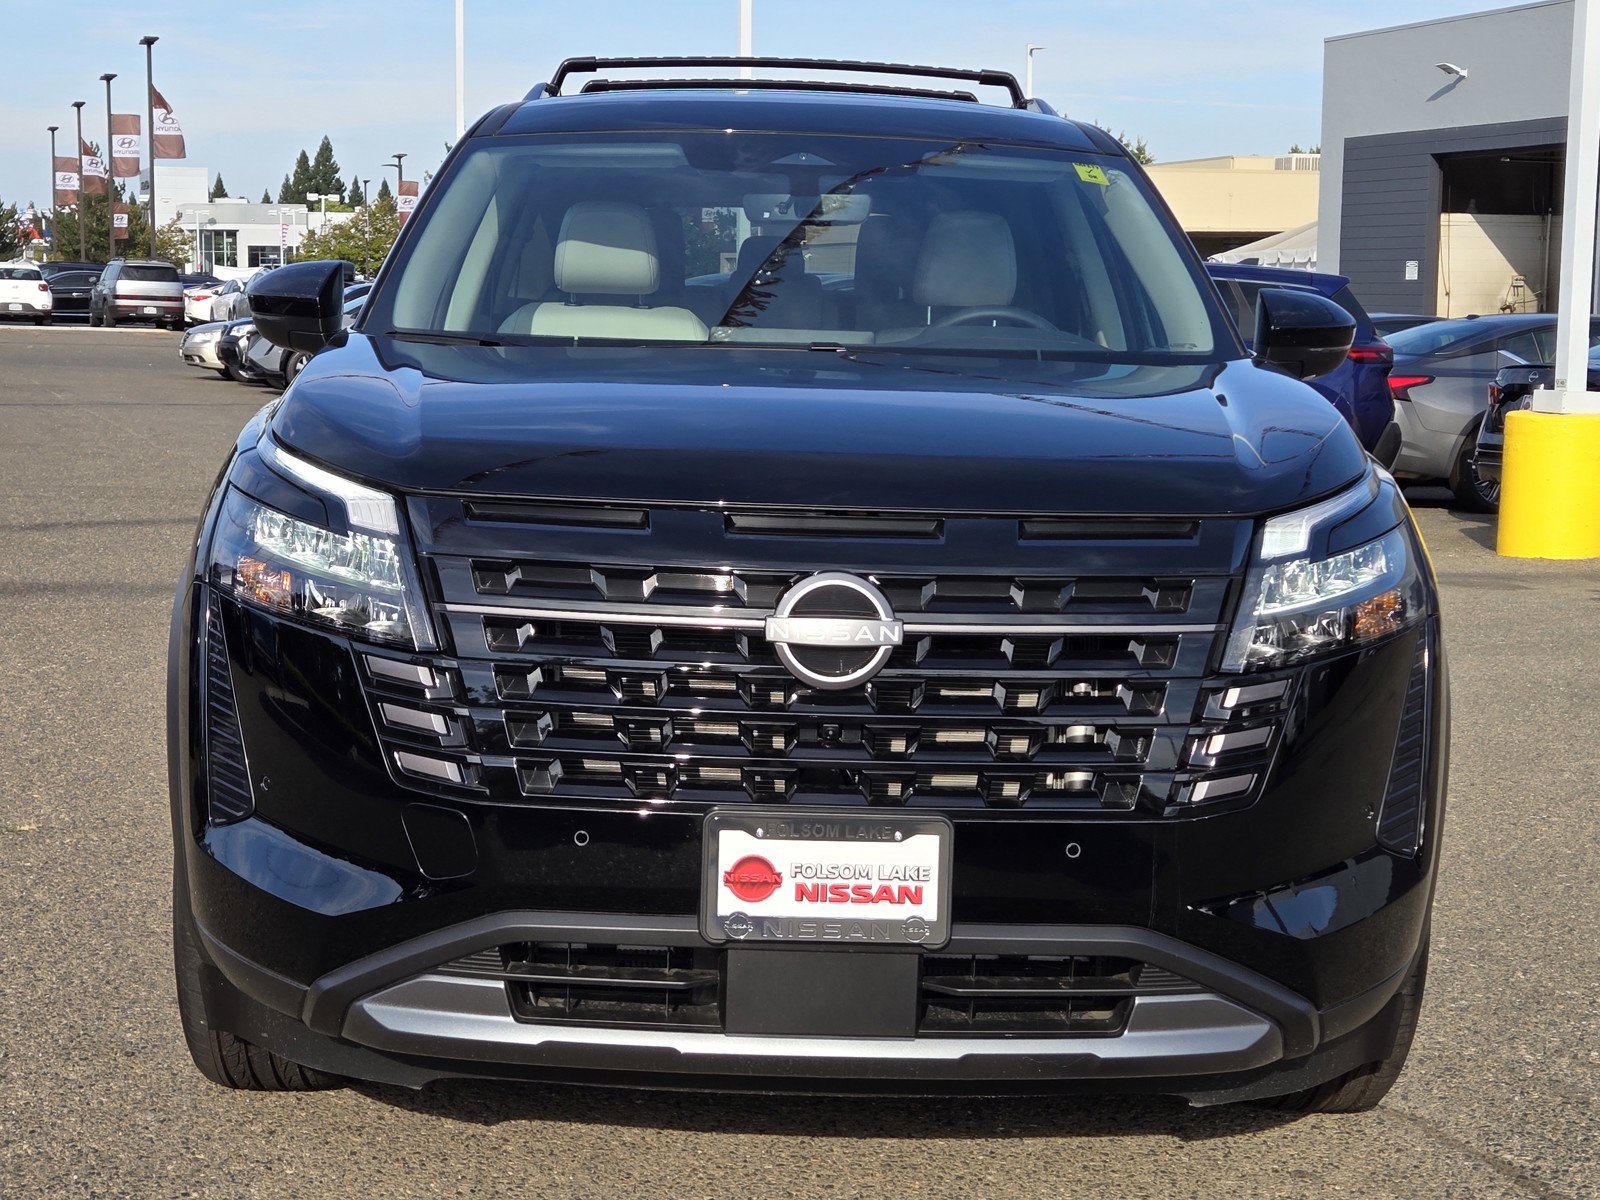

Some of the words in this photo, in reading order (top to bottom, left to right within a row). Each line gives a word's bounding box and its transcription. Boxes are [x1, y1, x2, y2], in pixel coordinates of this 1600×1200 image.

[769, 622, 900, 642] NISSAN
[767, 823, 840, 838] FOLSOM
[845, 825, 892, 839] LAKE
[723, 872, 783, 884] NISSAN
[790, 862, 872, 880] FOLSOM
[878, 864, 931, 882] LAKE
[795, 882, 923, 905] NISSAN
[762, 920, 890, 939] NISSAN
